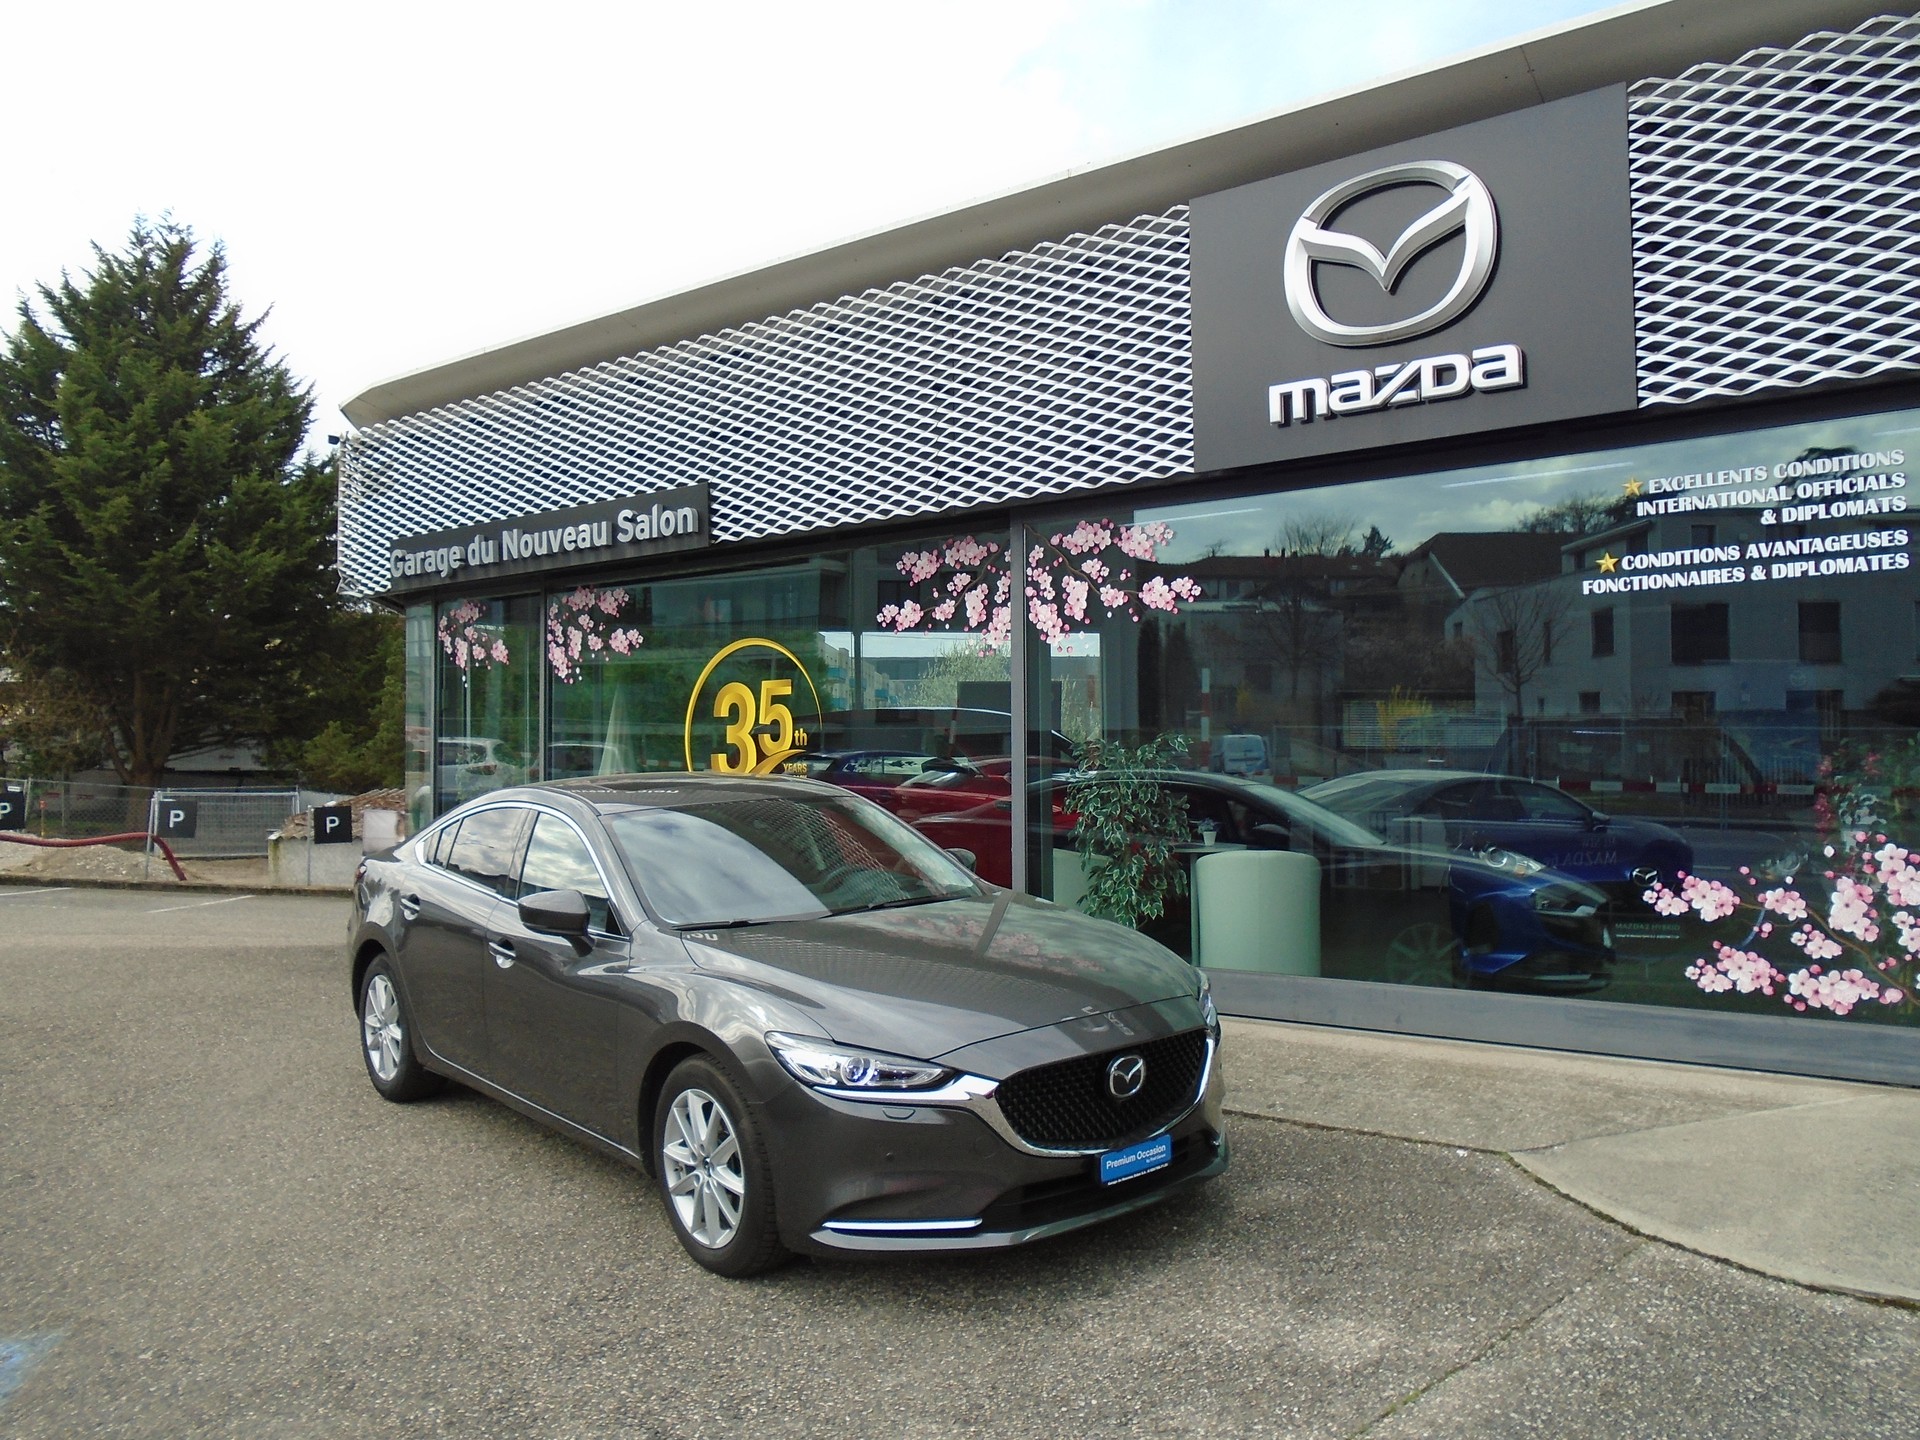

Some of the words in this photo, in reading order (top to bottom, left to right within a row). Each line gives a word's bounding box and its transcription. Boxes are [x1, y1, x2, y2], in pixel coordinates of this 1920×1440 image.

[1648, 465, 1768, 494] EXCELLENTS
[1773, 449, 1905, 479] CONDITIONS
[1636, 488, 1791, 517] INTERNATIONAL
[1797, 472, 1906, 500] OFFICIALS
[1760, 509, 1777, 525] &
[1782, 495, 1907, 523] DIPLOMATS
[390, 546, 464, 578] Garage
[467, 534, 498, 566] du
[502, 520, 612, 561] Nouveau
[617, 503, 699, 543] Salon
[1621, 545, 1741, 571] CONDITIONS
[1745, 529, 1909, 560] AVANTAGEUSES
[1582, 567, 1746, 595] FONCTIONNAIRES
[1750, 565, 1767, 581] &
[1771, 553, 1910, 580] DIPLOMATES
[783, 763, 808, 773] YEARS
[169, 809, 184, 829] P
[326, 816, 340, 835] P
[1106, 1155, 1136, 1169] Premium
[1136, 1145, 1166, 1160] Occasion
